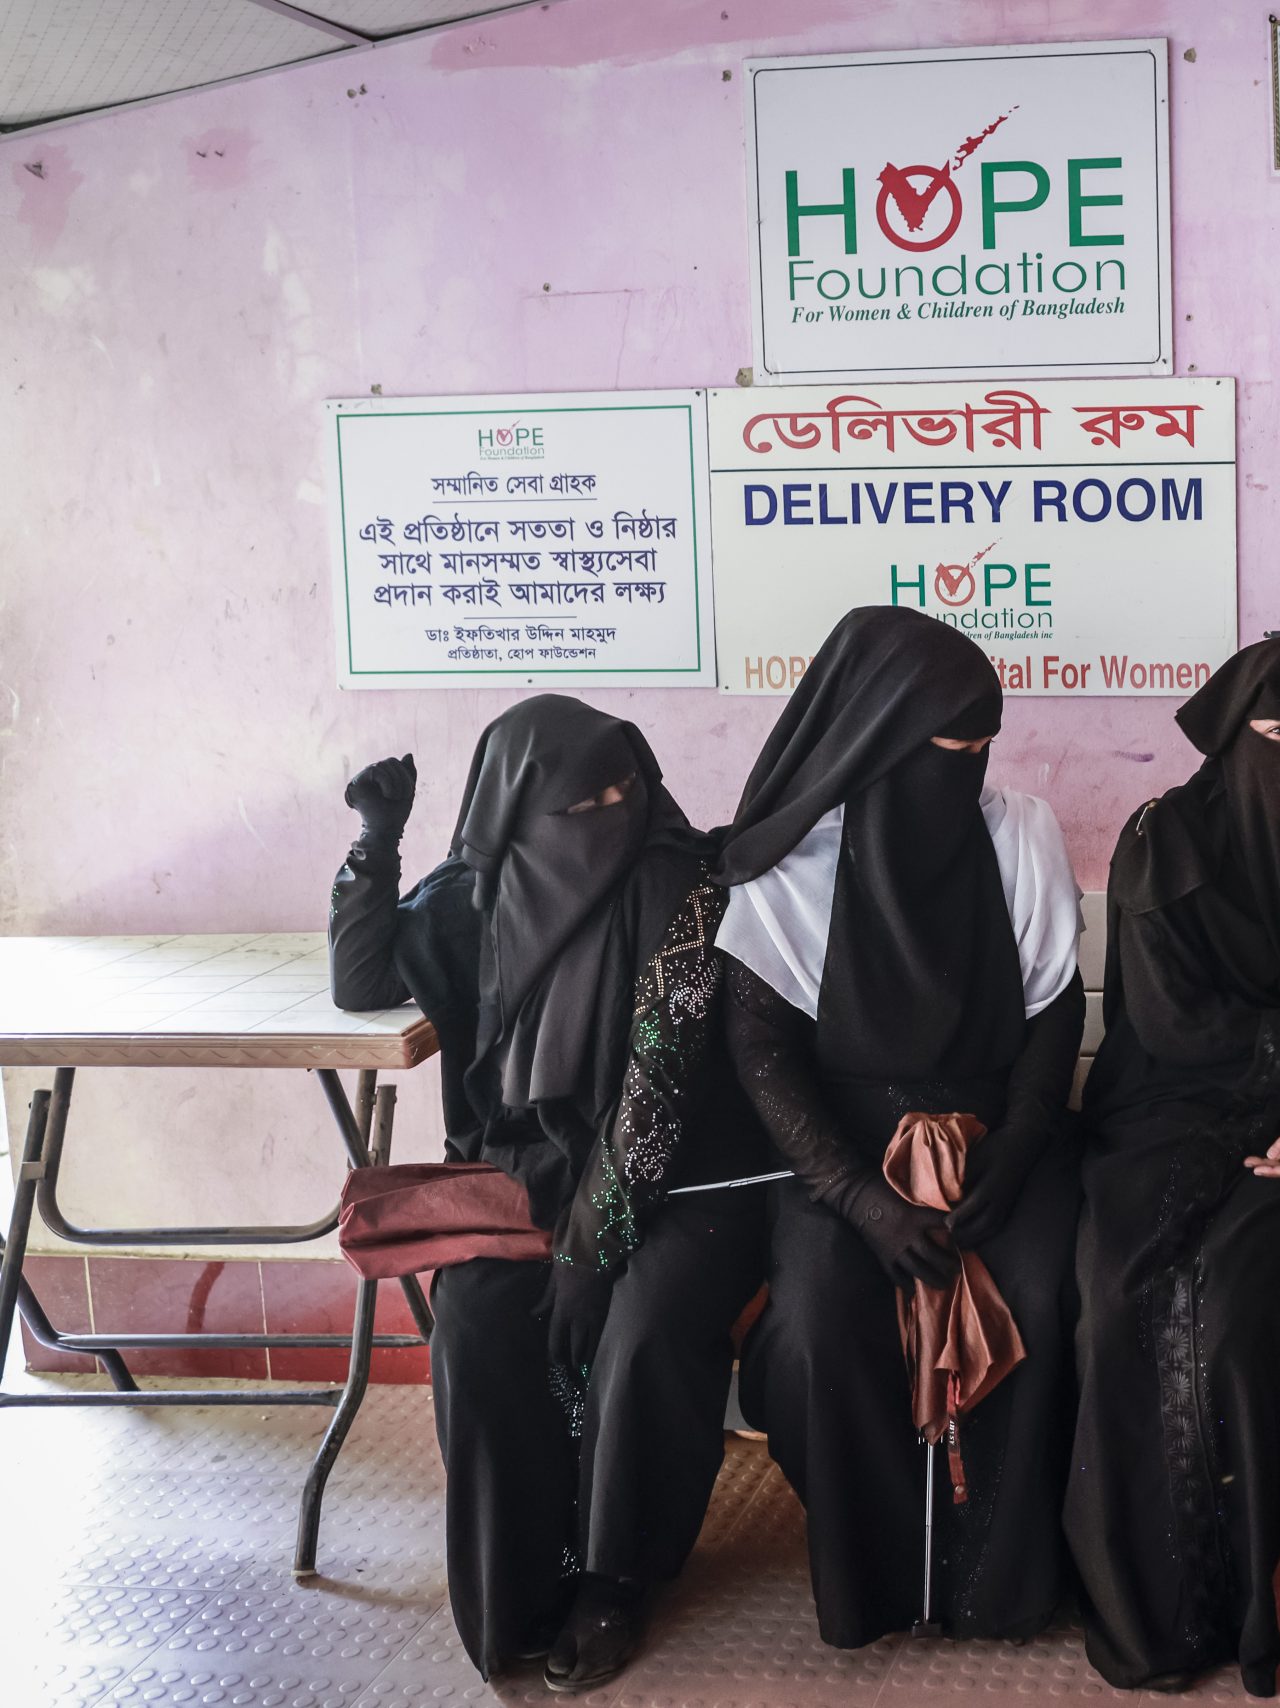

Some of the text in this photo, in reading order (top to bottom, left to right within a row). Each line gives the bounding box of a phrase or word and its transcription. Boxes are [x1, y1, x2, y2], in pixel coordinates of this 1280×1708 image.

[785, 157, 1124, 256] HOPE
[788, 252, 1125, 301] Foundation
[792, 297, 1124, 323] For Women & Children of Bangladesh
[741, 388, 1204, 453] ডেলিভারী রুম
[479, 428, 544, 447] HOPE
[479, 447, 544, 456] Foundation
[431, 471, 596, 495] সম্মানিত সেবা গ্রাহক
[744, 478, 1202, 525] DELIVERY ROOM
[360, 509, 677, 546] এই প্রতিষ্ঠানে সততা ও নিষ্ঠার
[378, 548, 657, 577] সাথে মানসম্মত স্বাস্থ্যসেবা
[374, 577, 666, 607] প্রদান করাই আমাদের লক্ষ্য
[889, 561, 1051, 607] HOPE
[926, 608, 1053, 628] ndation
[425, 625, 616, 643] ডাঃ ইফতিখার উদ্দিন মাহমুদ
[984, 630, 992, 640] of
[994, 631, 1039, 640] Bangladesh
[448, 645, 596, 662] প্রতিষ্ঠাতা, হোপ ফাউন্ডেশন
[744, 655, 814, 689] HOP
[1043, 656, 1090, 689] For
[1100, 656, 1212, 690] Women
